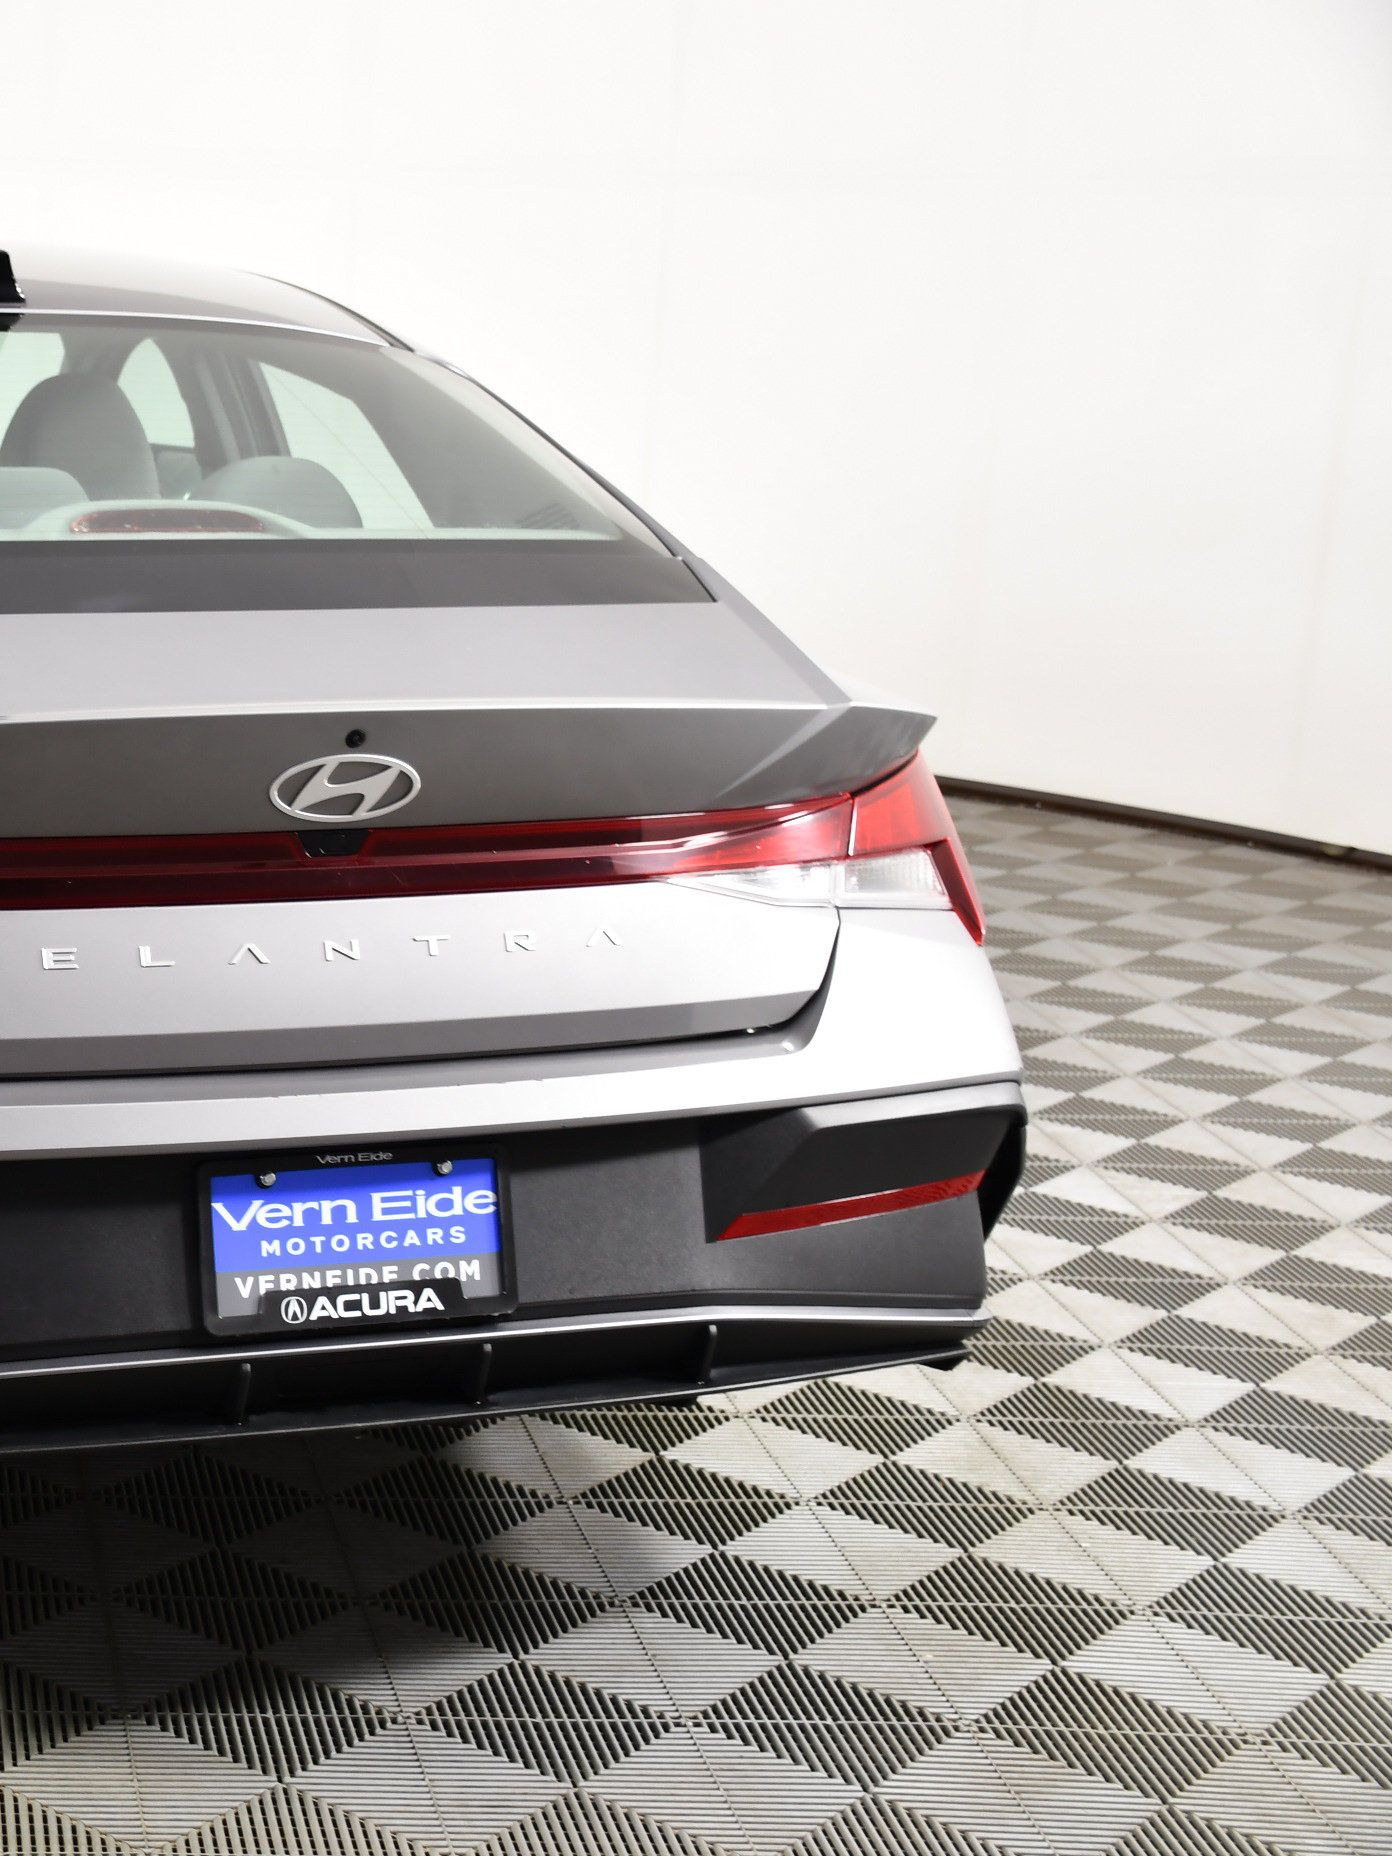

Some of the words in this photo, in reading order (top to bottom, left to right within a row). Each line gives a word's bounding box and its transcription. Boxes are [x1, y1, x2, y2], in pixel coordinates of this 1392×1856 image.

[41, 927, 623, 970] ELANTRA
[316, 1152, 355, 1164] Vern
[358, 1151, 394, 1162] Eide
[211, 1198, 358, 1231] Vern
[370, 1186, 498, 1222] Eide
[261, 1226, 466, 1257] MOTORCARS
[309, 1287, 446, 1321] ACURA
